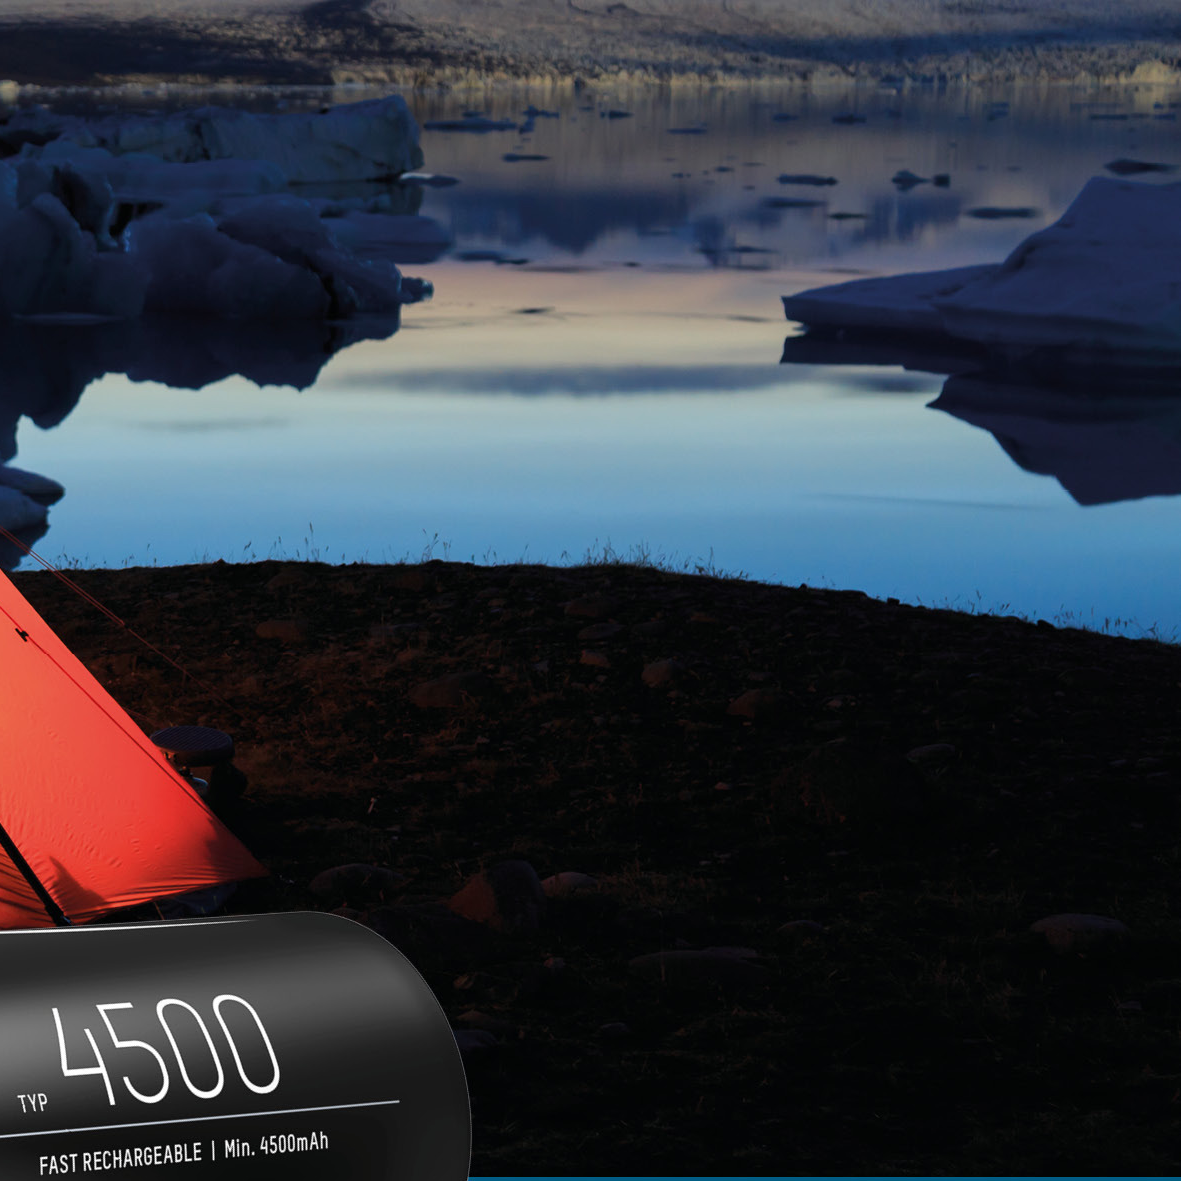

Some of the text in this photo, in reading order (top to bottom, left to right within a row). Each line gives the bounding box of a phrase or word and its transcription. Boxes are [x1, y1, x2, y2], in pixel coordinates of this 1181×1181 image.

[17, 994, 281, 1113] TYP 4500
[39, 1153, 78, 1176] FAST
[82, 1142, 202, 1172] RECHARGEABLE
[224, 1138, 256, 1158] Min.
[259, 1131, 329, 1155] 4500mAh
